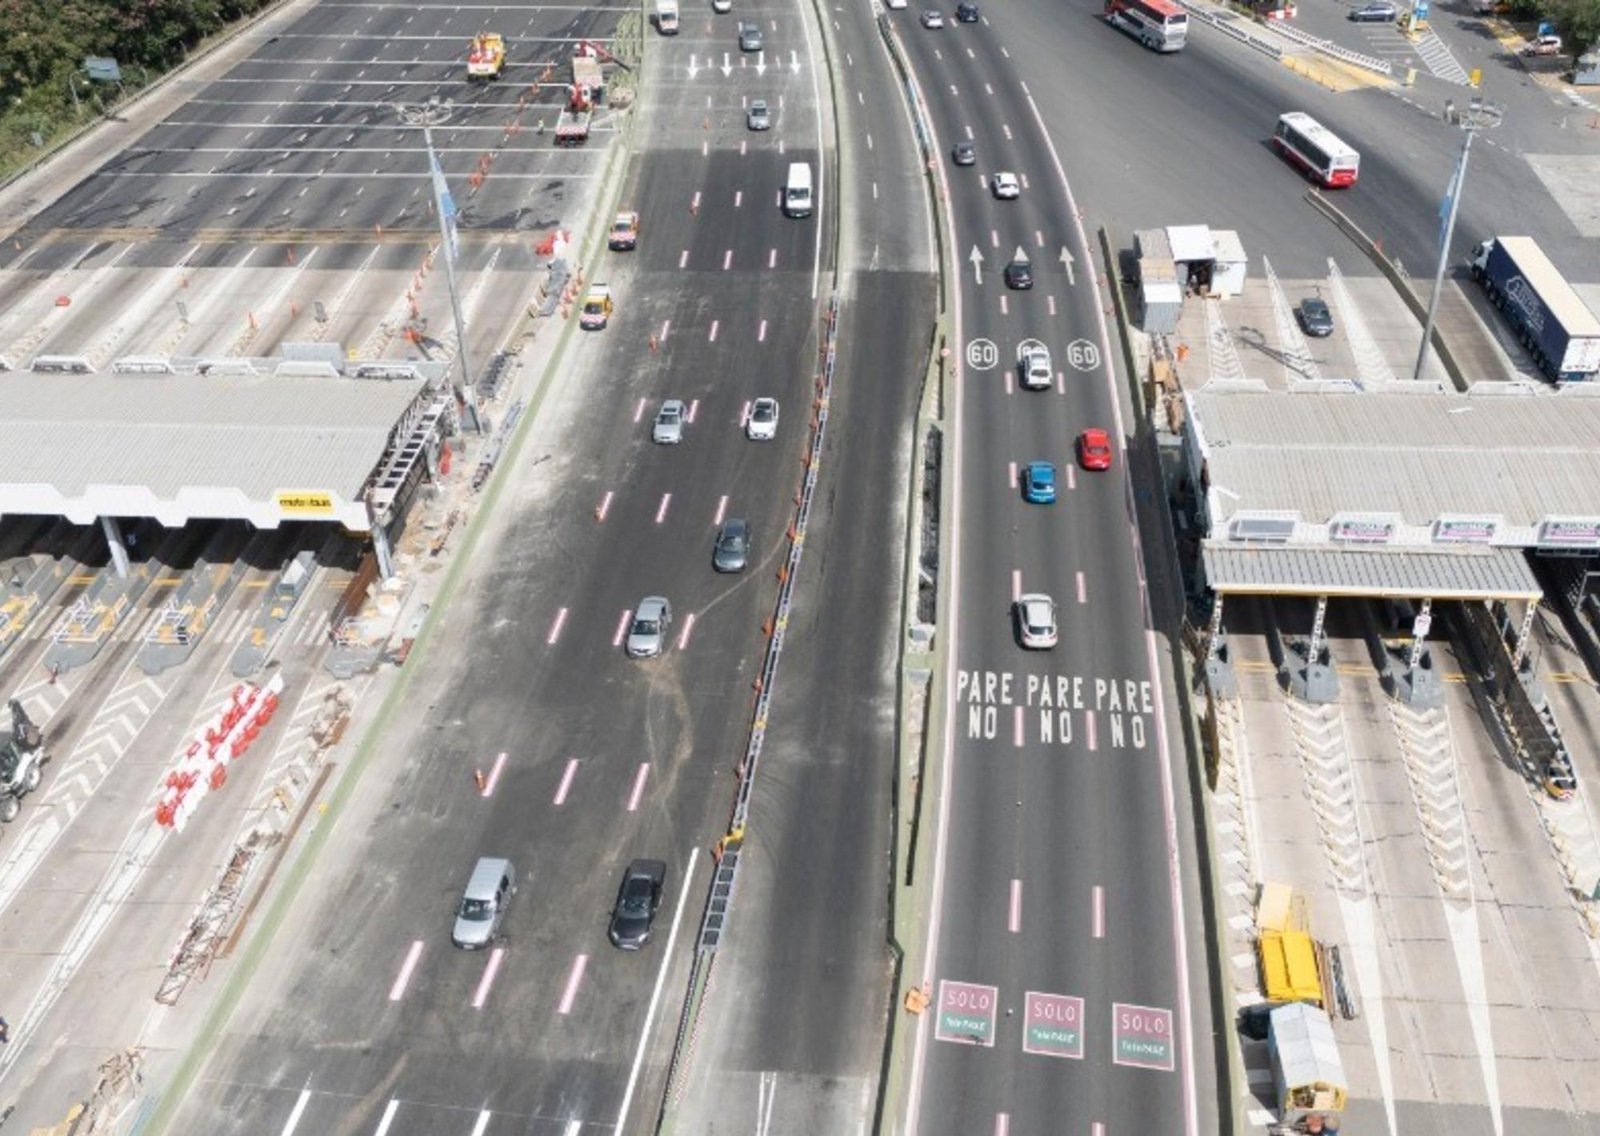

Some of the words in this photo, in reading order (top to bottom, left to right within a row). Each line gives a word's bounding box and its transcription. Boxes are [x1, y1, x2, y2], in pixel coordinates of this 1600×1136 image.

[971, 345, 993, 363] 60
[1073, 346, 1095, 364] 60
[957, 670, 1014, 705] PARE
[1027, 674, 1084, 709] PARE
[1096, 678, 1154, 713] PARE
[968, 705, 997, 740] NO
[1040, 709, 1072, 744] NO
[1110, 713, 1146, 749] NO
[946, 991, 989, 1010] SOLO
[1034, 1001, 1075, 1022] SOLO
[1122, 1013, 1165, 1034] SOLO
